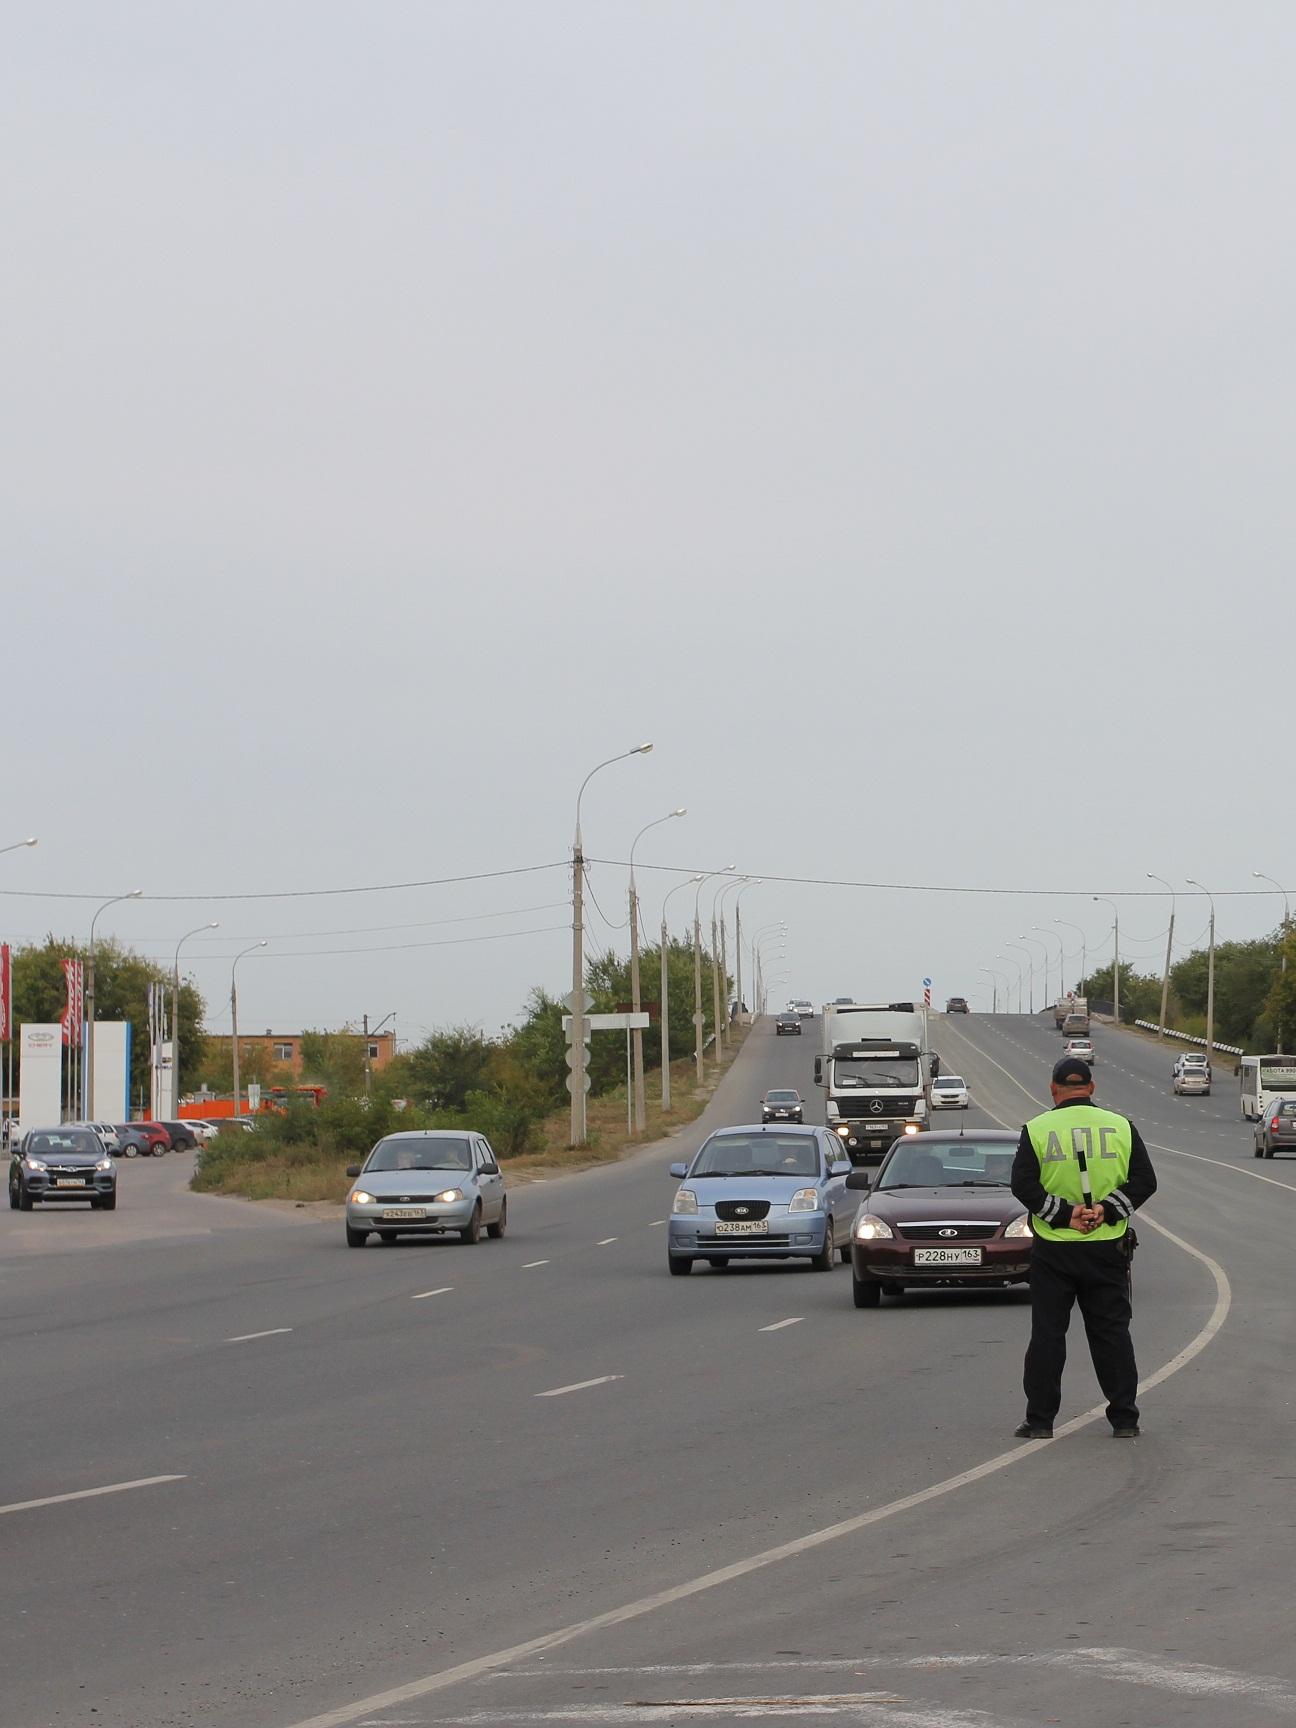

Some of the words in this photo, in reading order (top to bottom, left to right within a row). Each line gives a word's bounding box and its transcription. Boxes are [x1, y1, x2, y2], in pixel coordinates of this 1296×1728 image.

[1042, 1127, 1117, 1163] ДПС
[753, 1221, 767, 1229] 163
[962, 1249, 978, 1258] 163
